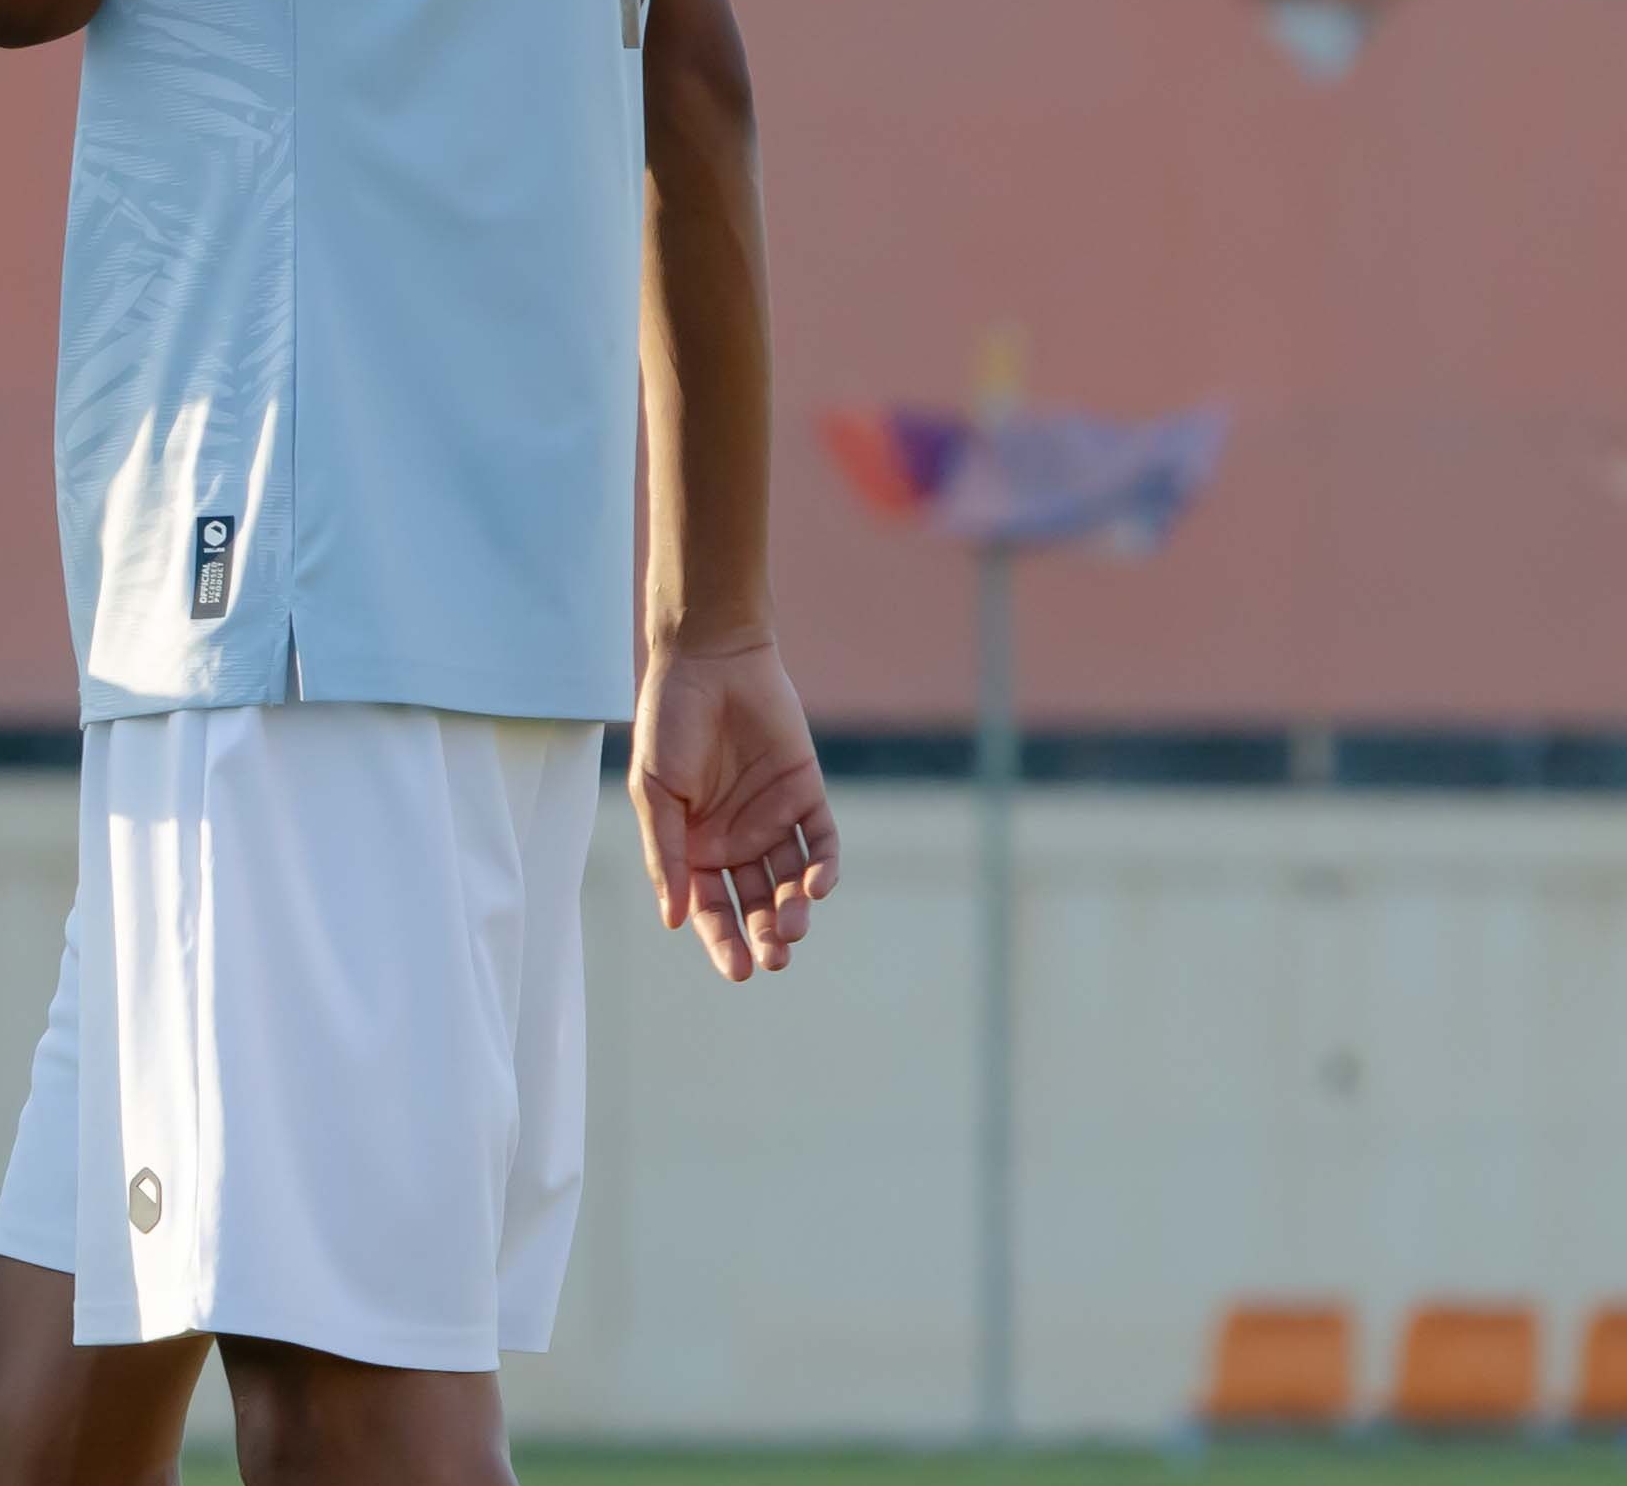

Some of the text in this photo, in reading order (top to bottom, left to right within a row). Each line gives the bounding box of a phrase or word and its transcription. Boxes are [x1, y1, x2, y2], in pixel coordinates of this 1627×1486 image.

[199, 563, 212, 604] OFFICIAL
[207, 561, 218, 604] LICENSED
[213, 562, 225, 603] PRODUCT
